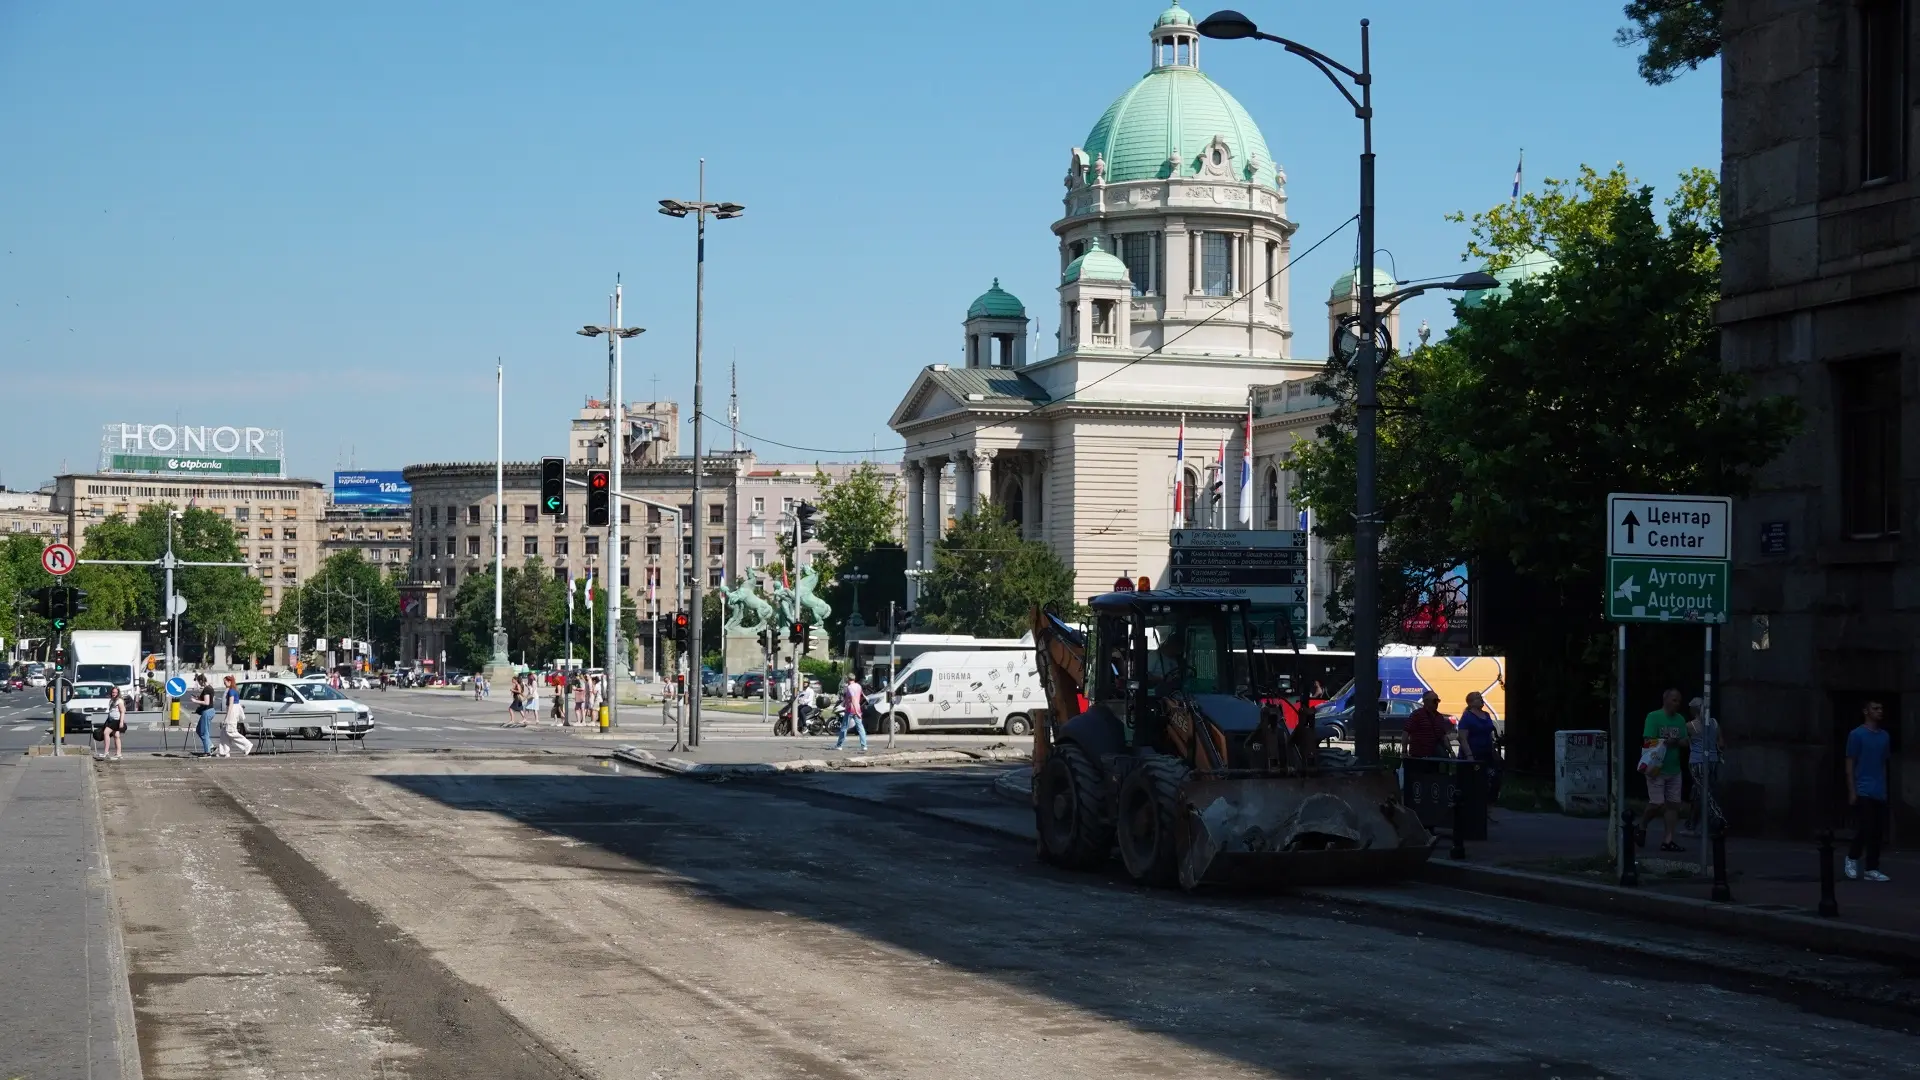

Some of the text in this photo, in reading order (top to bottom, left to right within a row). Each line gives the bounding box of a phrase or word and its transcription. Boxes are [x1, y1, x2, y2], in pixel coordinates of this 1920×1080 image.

[121, 423, 265, 453] HONOR
[180, 459, 222, 470] otpbanka
[379, 482, 397, 492] 120
[1648, 506, 1711, 528] Центар
[1648, 530, 1704, 548] Centar
[1648, 567, 1716, 589] Аутопут
[1647, 591, 1713, 610] Autoput
[938, 672, 971, 680] DIORAMA
